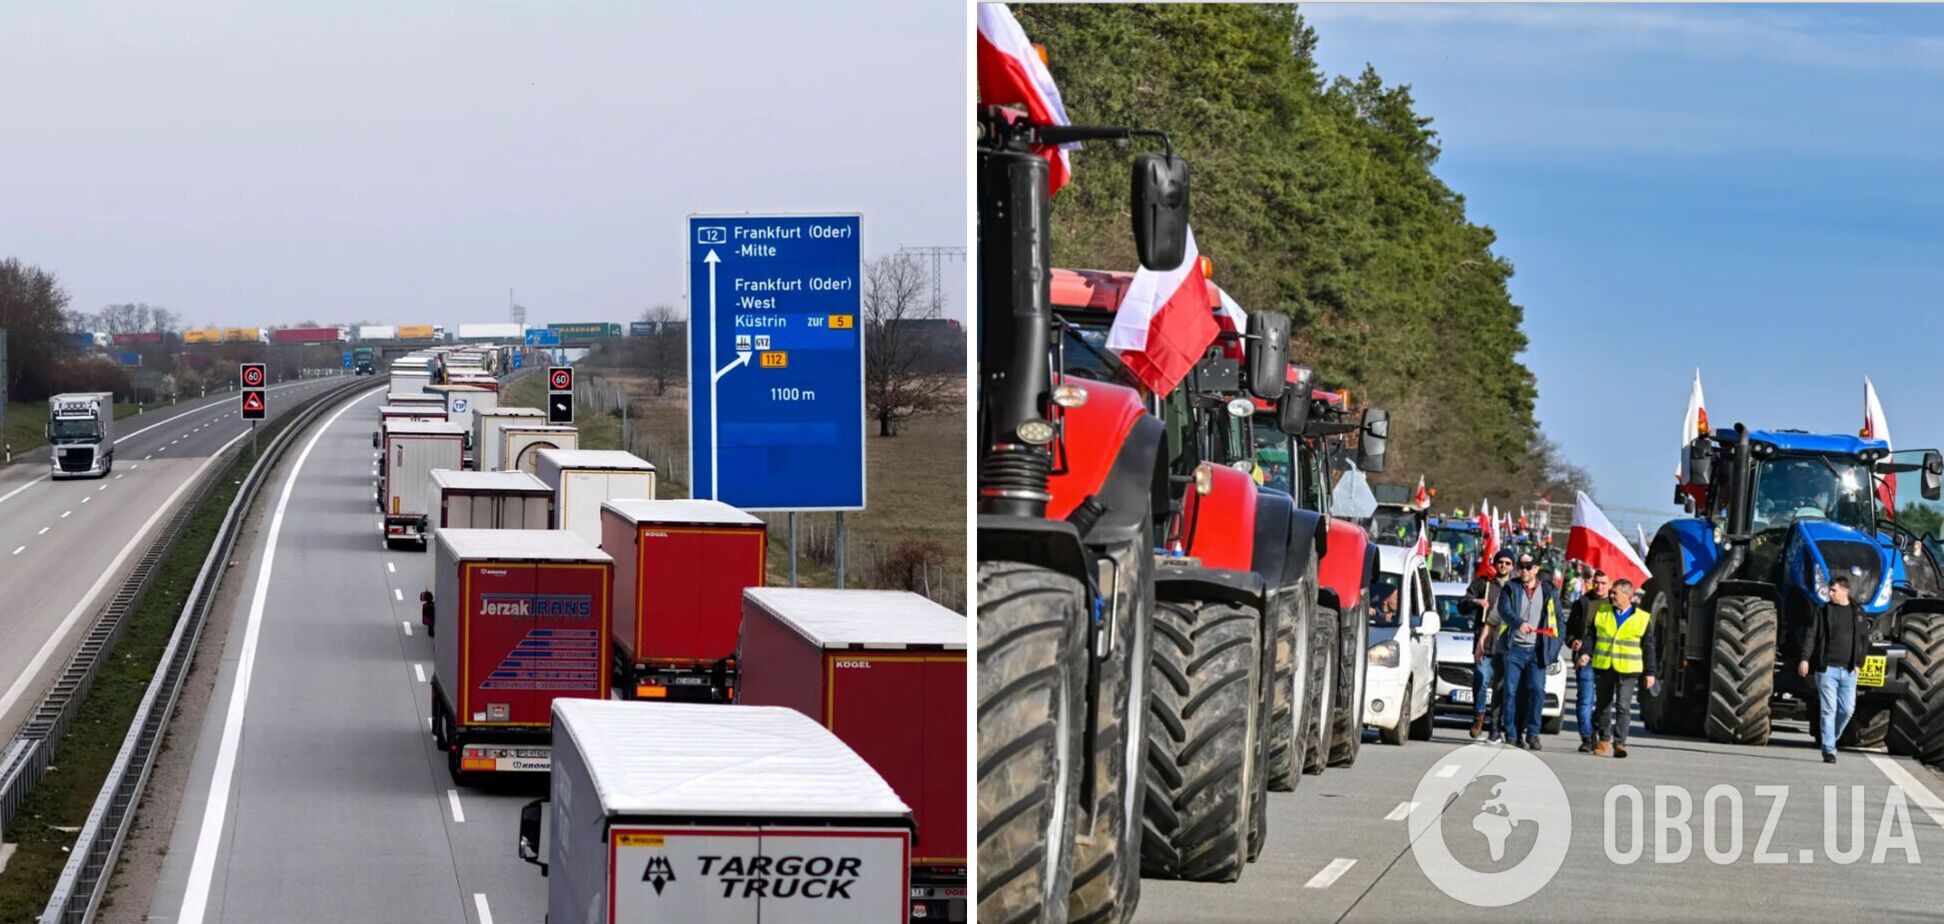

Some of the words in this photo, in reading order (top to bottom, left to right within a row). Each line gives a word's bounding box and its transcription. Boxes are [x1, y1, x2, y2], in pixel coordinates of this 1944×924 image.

[706, 230, 718, 241] 12
[734, 226, 801, 239] Frankfurt
[809, 225, 851, 240] (Oder)
[735, 244, 776, 257] -Mitte
[735, 278, 801, 291] Frankfurt
[809, 277, 852, 291] (Oder)
[735, 297, 776, 309] -West
[735, 314, 787, 328] Küstrin
[808, 317, 824, 327] zur
[837, 317, 844, 327] 5
[766, 355, 782, 365] 112
[248, 372, 258, 381] 60
[556, 375, 566, 384] 60
[771, 388, 799, 400] 1100
[802, 391, 815, 400] m
[698, 856, 862, 877] TARGOR
[720, 878, 855, 899] TRUCK
